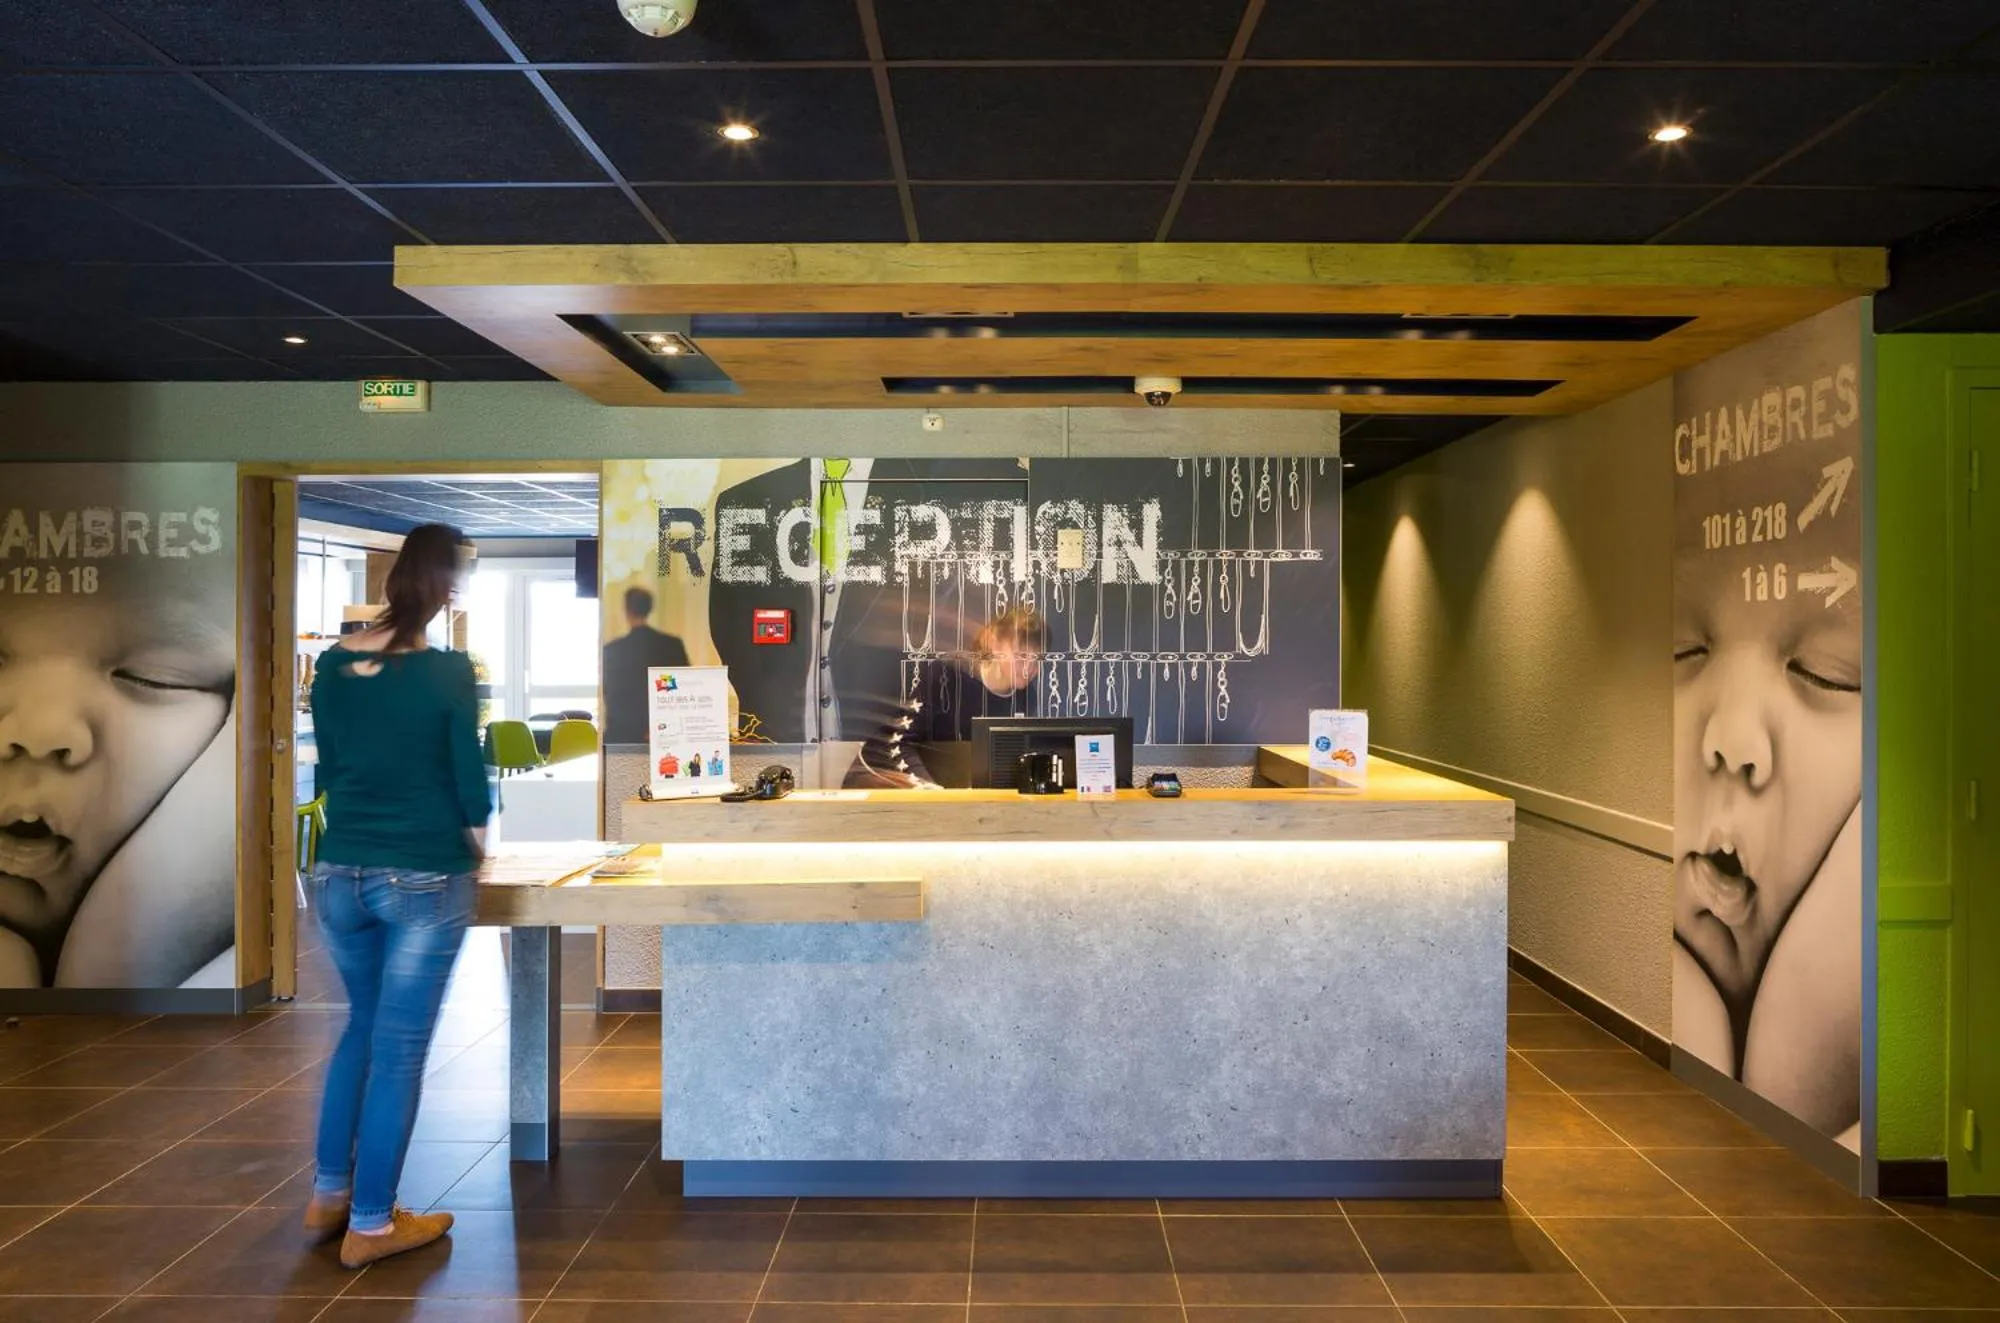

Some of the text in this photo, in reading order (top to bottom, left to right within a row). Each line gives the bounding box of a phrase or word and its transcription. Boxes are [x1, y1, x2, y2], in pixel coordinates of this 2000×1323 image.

[364, 382, 415, 394] SORTIE
[1674, 362, 1860, 476] CHAMBRES
[0, 506, 222, 559] AMBRES
[656, 498, 1162, 585] RECEPTION
[1703, 502, 1787, 549] 101 à 218
[9, 566, 98, 594] 12 à 18
[1741, 563, 1787, 601] 1 à 6
